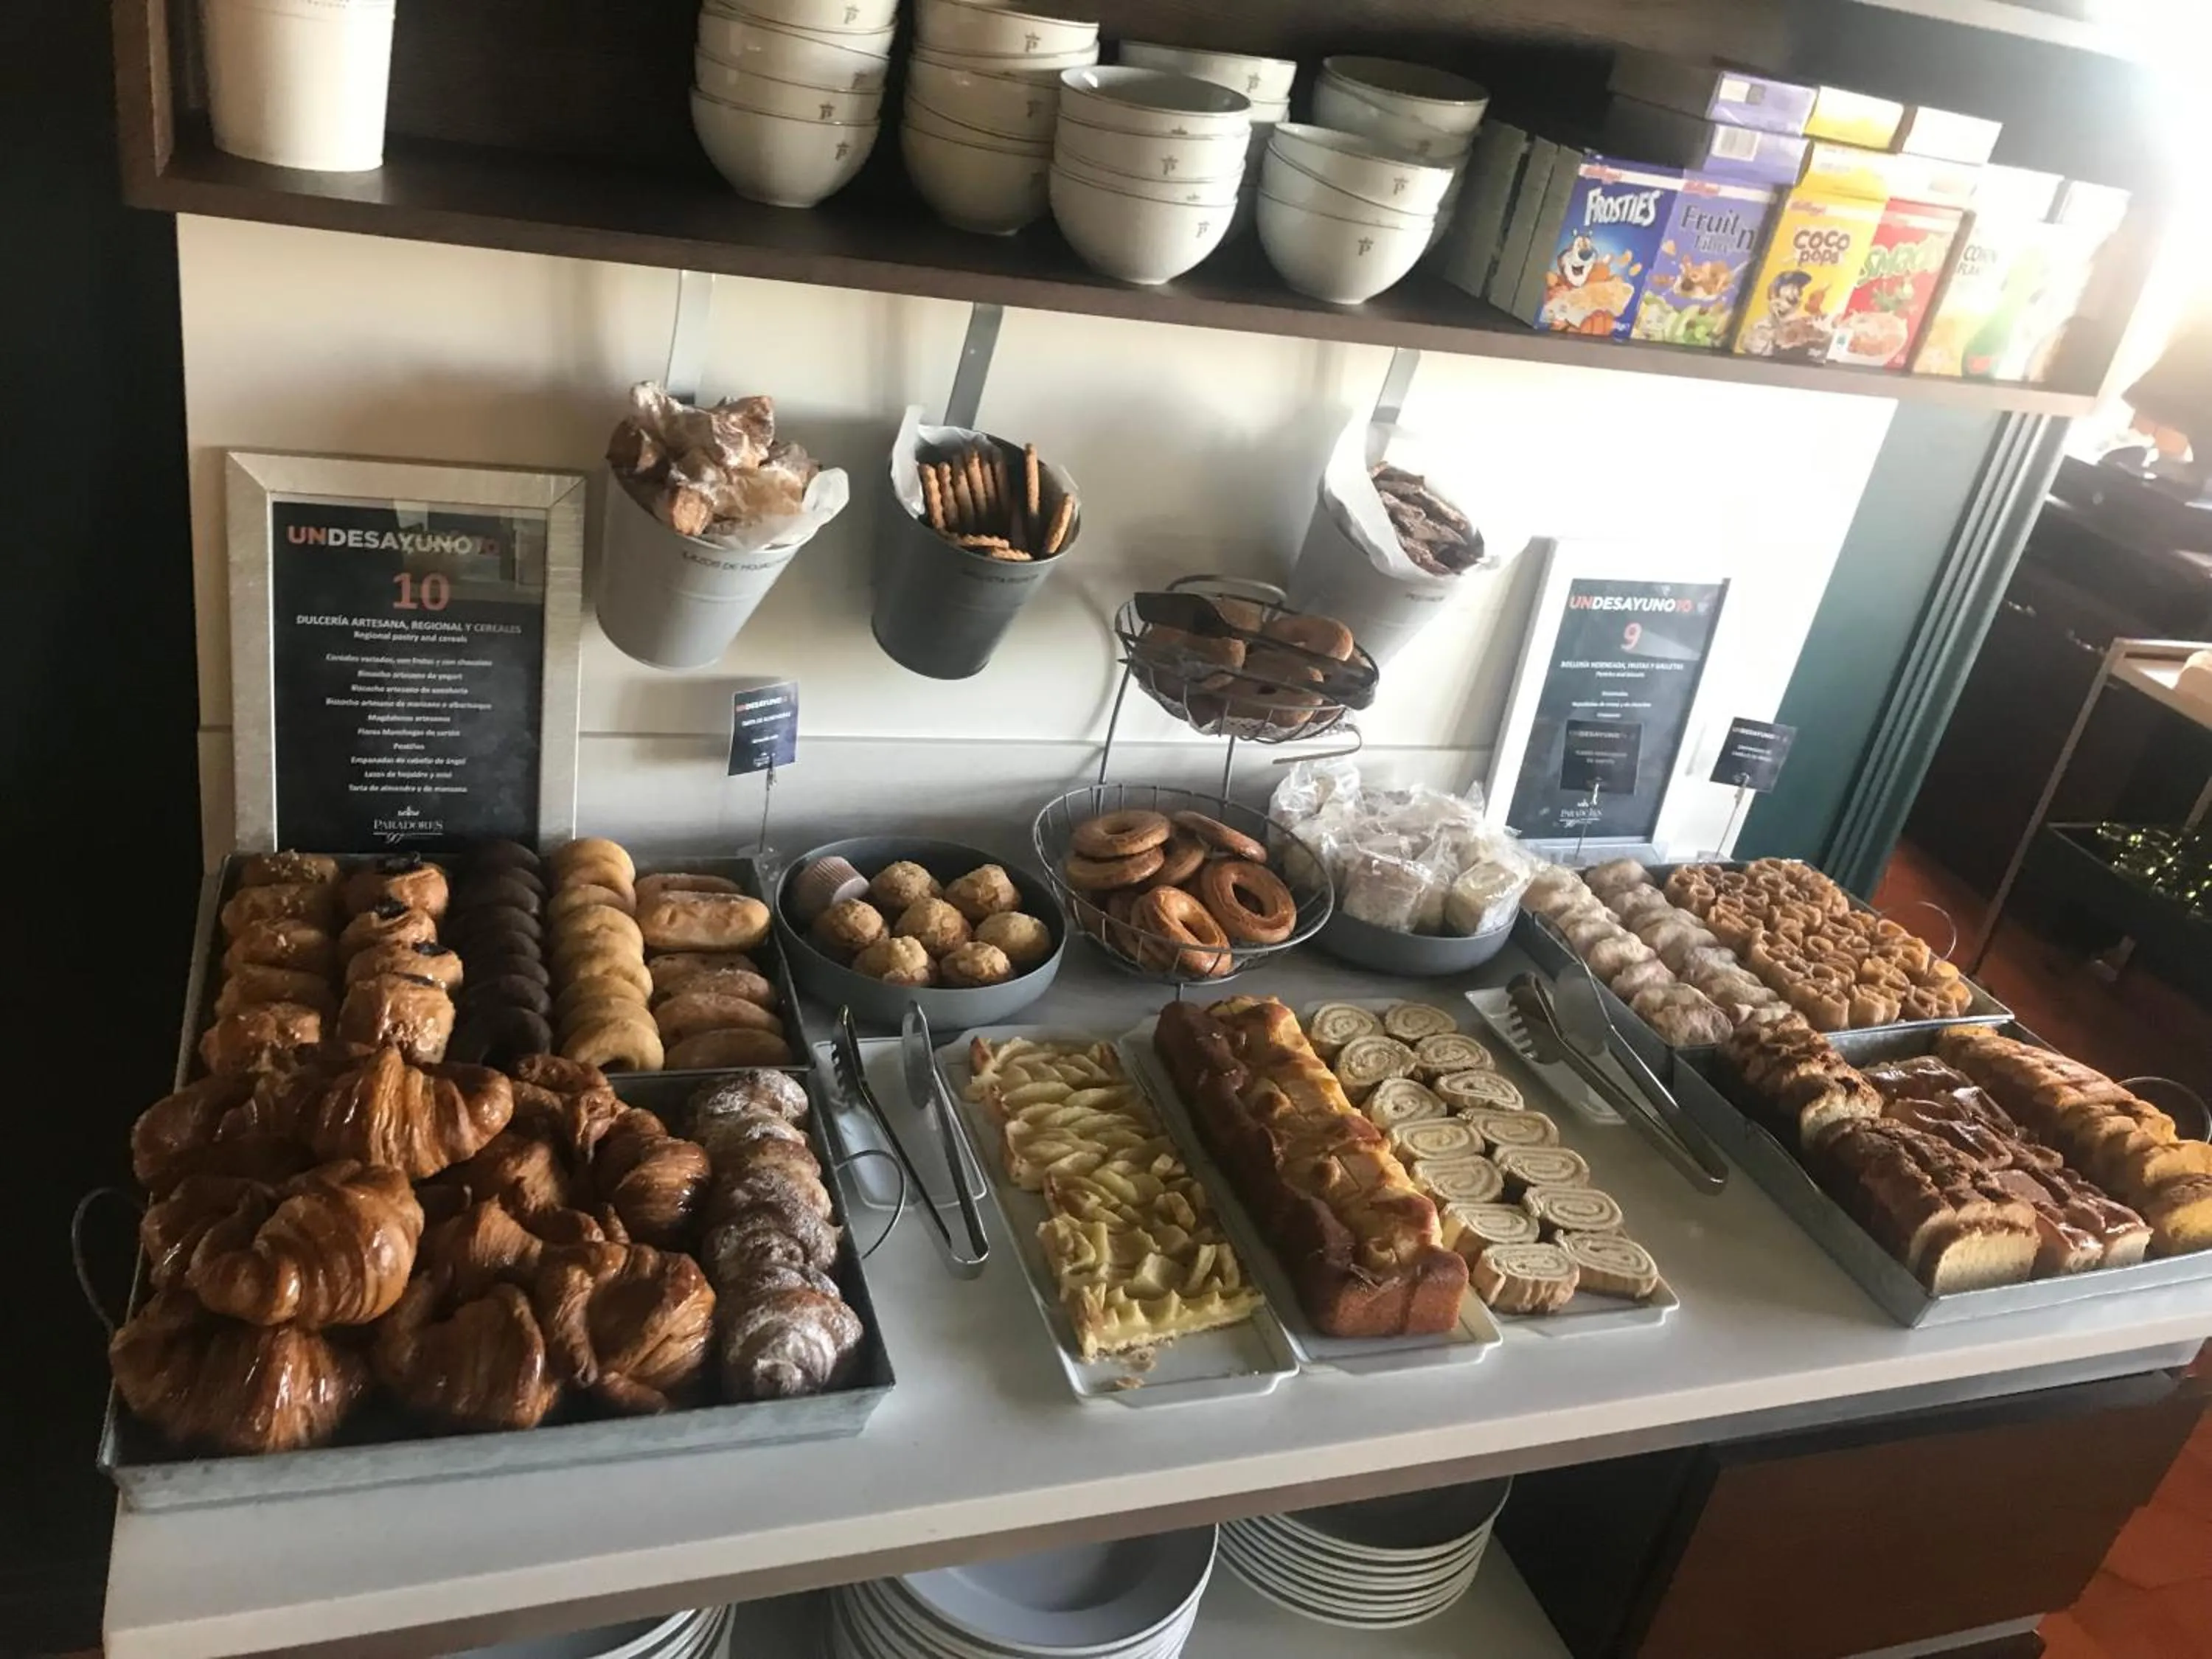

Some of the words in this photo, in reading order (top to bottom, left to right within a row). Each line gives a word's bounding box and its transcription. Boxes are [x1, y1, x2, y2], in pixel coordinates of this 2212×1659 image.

[1681, 204, 1739, 234] Fruit
[392, 572, 451, 611] 10
[296, 615, 349, 625] DULCERÍA
[351, 618, 407, 630] ARTESANA,
[411, 620, 462, 632] REGIONAL
[465, 623, 473, 631] Y
[474, 624, 522, 633] CEREALES
[1621, 622, 1642, 650] 9
[373, 819, 442, 830] PARADORES
